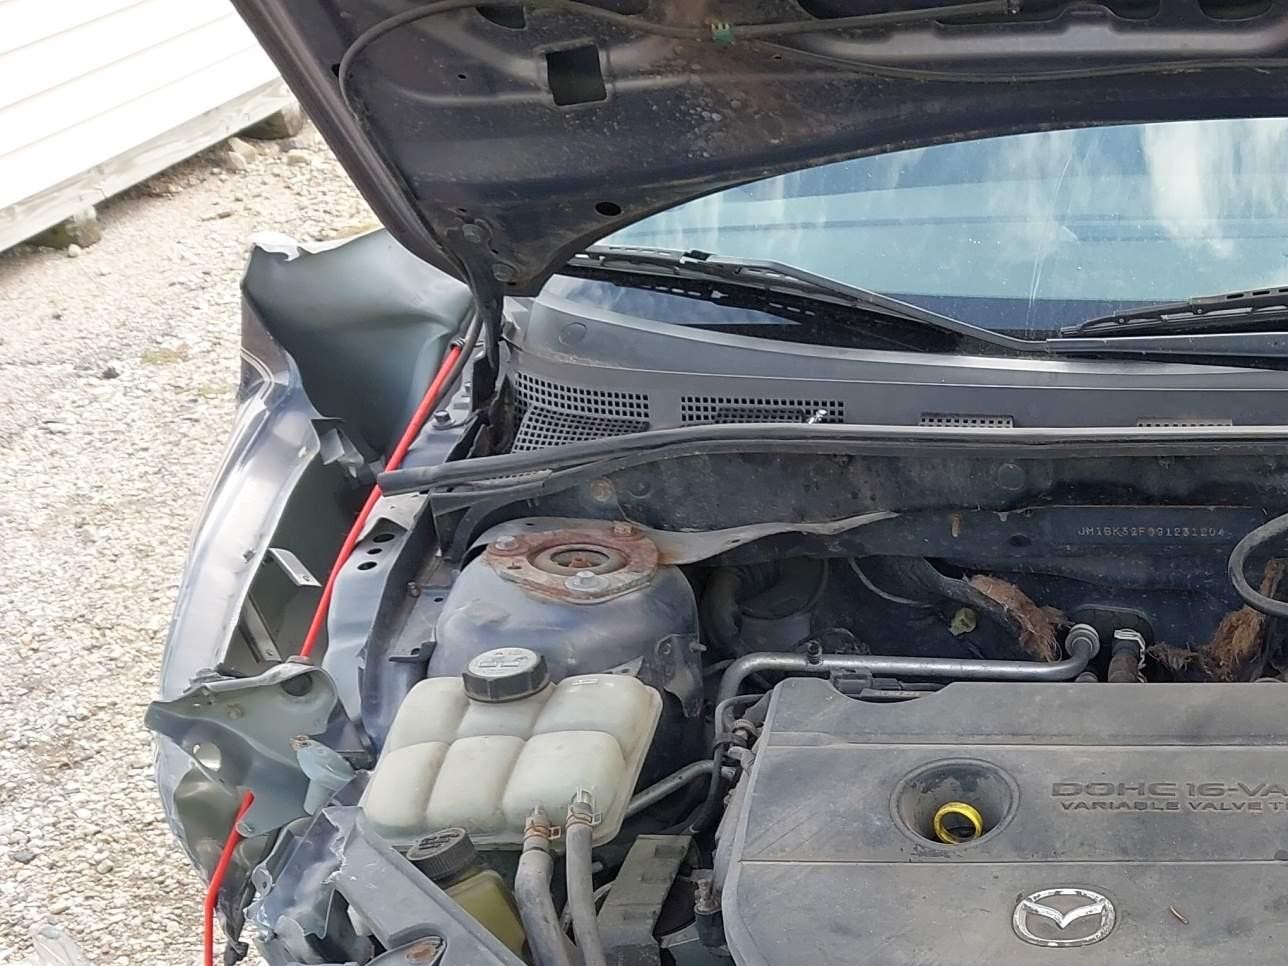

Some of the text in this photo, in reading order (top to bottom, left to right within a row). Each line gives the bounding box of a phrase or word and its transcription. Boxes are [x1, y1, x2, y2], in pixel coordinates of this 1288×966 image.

[1051, 782, 1177, 797] DOHC
[1060, 800, 1180, 812] VARIABLE
[1188, 800, 1262, 812] VALVE
